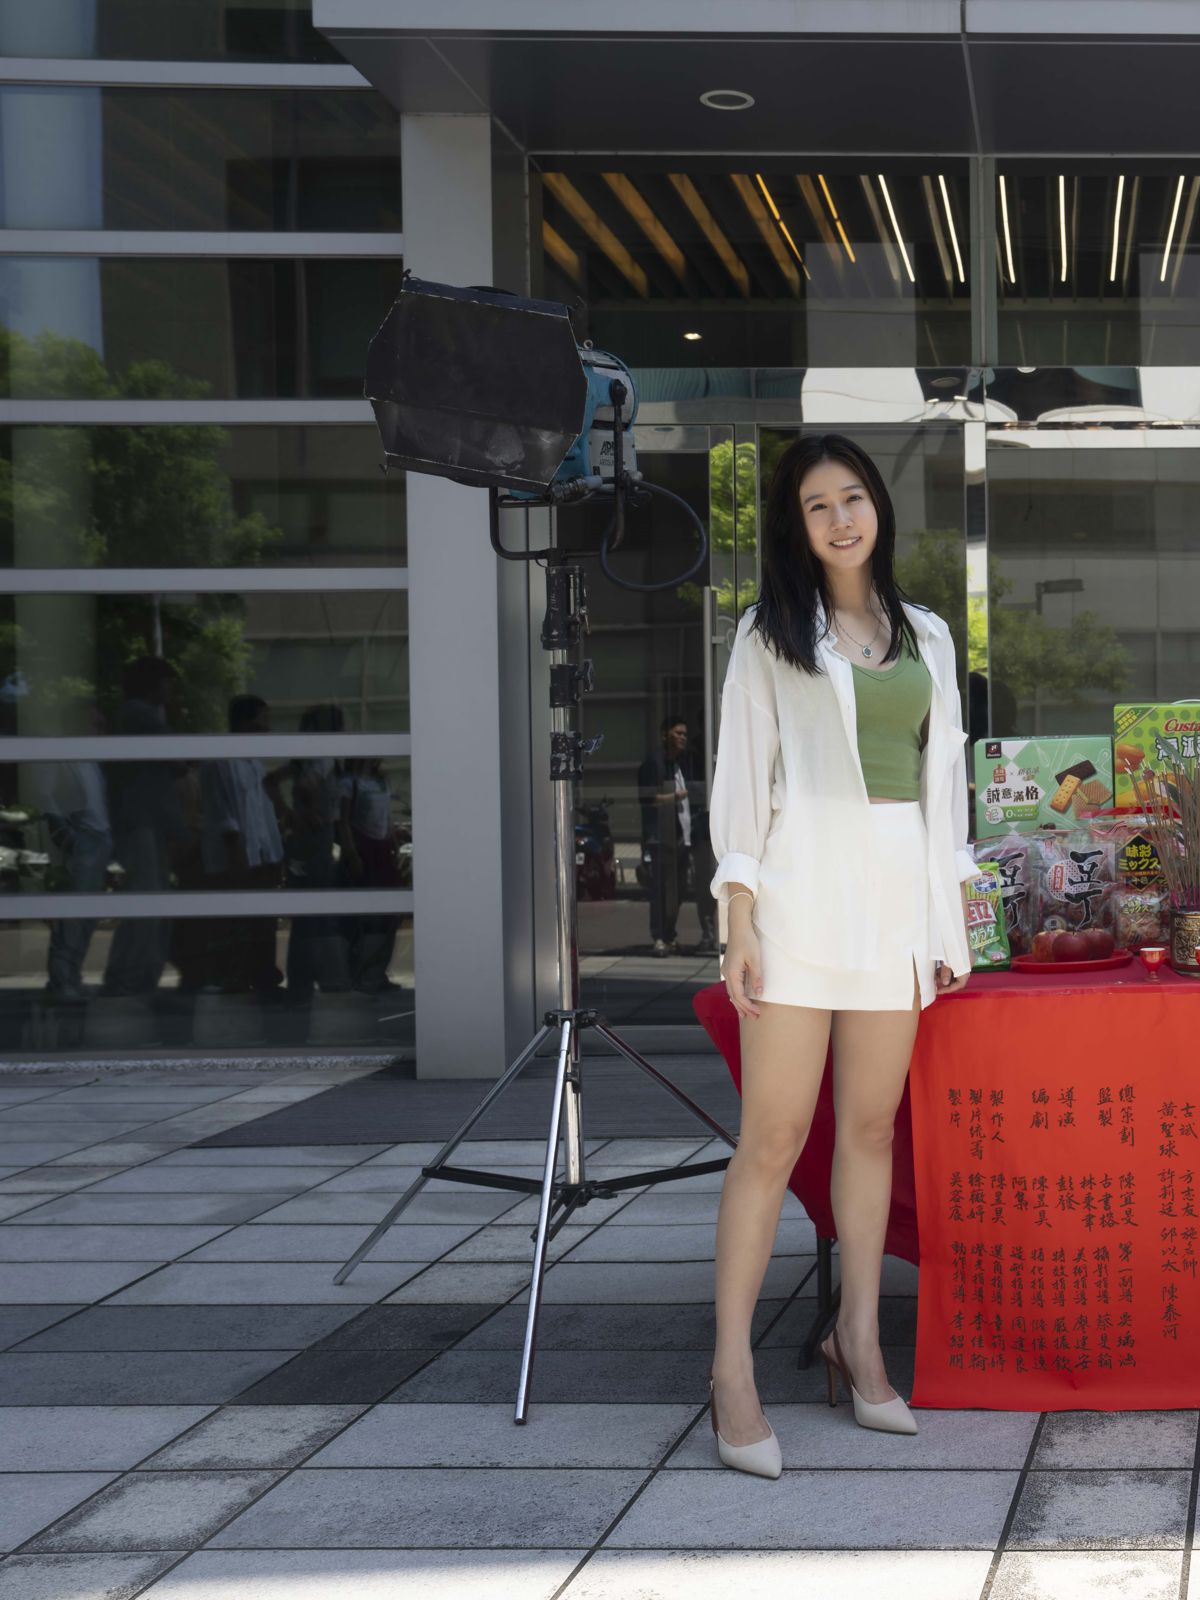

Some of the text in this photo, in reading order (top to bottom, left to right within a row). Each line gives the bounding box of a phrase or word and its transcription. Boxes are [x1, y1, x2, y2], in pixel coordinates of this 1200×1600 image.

[986, 785, 1040, 804] 誠意滿格
[1119, 857, 1159, 871] ミックス
[967, 901, 993, 921] ETZ
[949, 1088, 962, 1128] 製片
[990, 1089, 1005, 1143] 製作人
[1029, 1088, 1050, 1130] 編劇
[1058, 1086, 1077, 1128] 導演
[1097, 1087, 1114, 1127] 監製
[1119, 1084, 1136, 1147] 總策劃
[1180, 1169, 1199, 1217] 方志友
